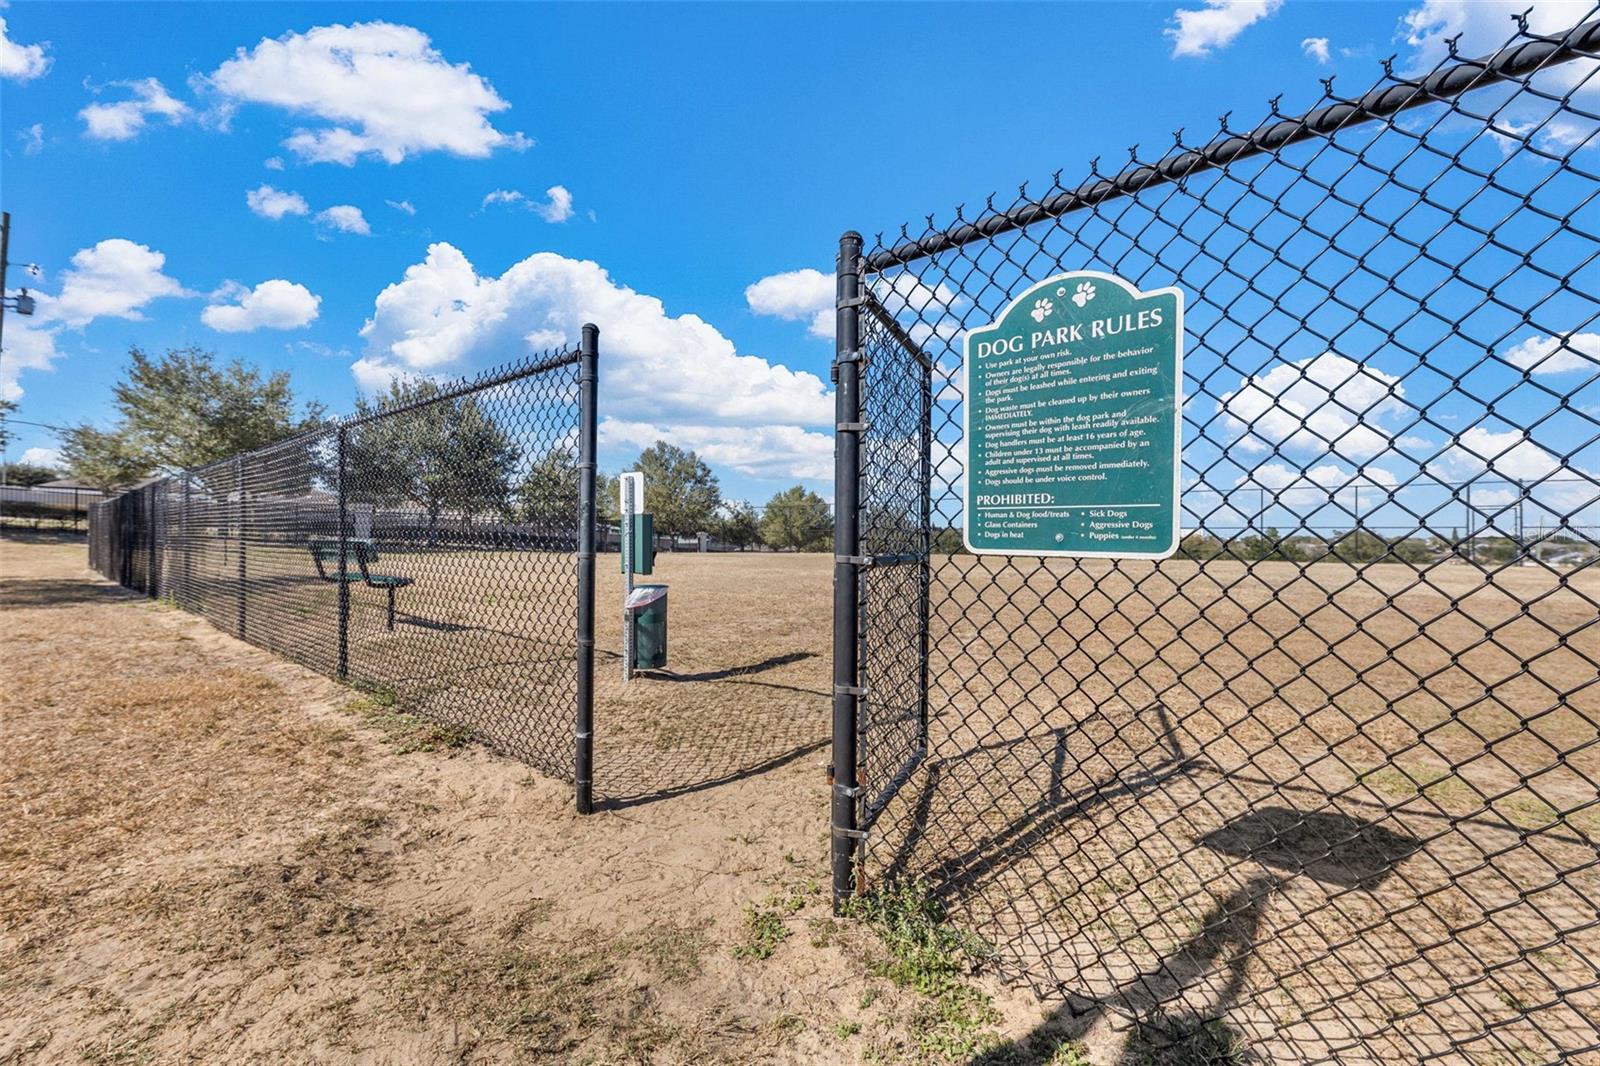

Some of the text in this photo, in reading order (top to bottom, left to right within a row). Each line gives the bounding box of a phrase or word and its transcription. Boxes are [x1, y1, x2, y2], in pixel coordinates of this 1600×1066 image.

[978, 308, 1163, 358] DOG PARK RULES
[985, 370, 1010, 379] Owners
[1024, 363, 1045, 374] legally
[1047, 357, 1088, 370] responsible
[1103, 353, 1115, 361] the
[1118, 348, 1154, 359] behavior
[998, 357, 1014, 369] park
[1023, 355, 1039, 365] your
[1056, 348, 1072, 358] risk.
[984, 368, 1158, 397] Dogs must be leashed while entering and exiting
[985, 378, 992, 386] of
[993, 376, 1008, 385] their
[1010, 372, 1030, 383] dog(s)
[1040, 370, 1049, 378] all
[985, 406, 999, 414] Dog
[1000, 404, 1018, 412] waste
[1019, 401, 1036, 410] must
[1048, 396, 1076, 406] cleaned
[1089, 394, 1098, 403] by
[1100, 392, 1118, 400] their
[1120, 389, 1150, 398] owners
[996, 394, 1013, 404] park.
[985, 410, 1033, 421] IMMEDIATELY.
[1039, 416, 1061, 425] within
[1063, 415, 1074, 423] the
[1076, 414, 1090, 422] dog
[1092, 411, 1109, 422] park
[1112, 409, 1126, 418] and
[986, 416, 1159, 439] supervising their dog with leash readily available.
[986, 441, 998, 450] Dog
[1000, 439, 1026, 447] handlers
[1097, 432, 1116, 441] years
[1119, 430, 1126, 438] of
[985, 450, 1012, 458] Children
[1013, 448, 1032, 456] under
[1075, 441, 1125, 452] accompanied
[1128, 440, 1137, 450] by
[1016, 454, 1051, 465] supervised
[985, 467, 1017, 477] Aggressive
[1019, 466, 1034, 475] dogs
[1066, 462, 1096, 471] removed
[1099, 460, 1149, 469] immediately.
[985, 477, 1001, 486] Dogs
[1002, 476, 1024, 484] should
[1034, 475, 1056, 483] under
[1077, 472, 1108, 481] control.
[977, 493, 1055, 505] PROHIBITED:
[1016, 510, 1031, 519] Dog
[1031, 510, 1070, 518] food/treats
[1106, 510, 1128, 518] Dogs
[1090, 521, 1153, 530] Aggressive Dogs
[985, 531, 1000, 540] Dogs
[1089, 532, 1119, 541] Puppies
